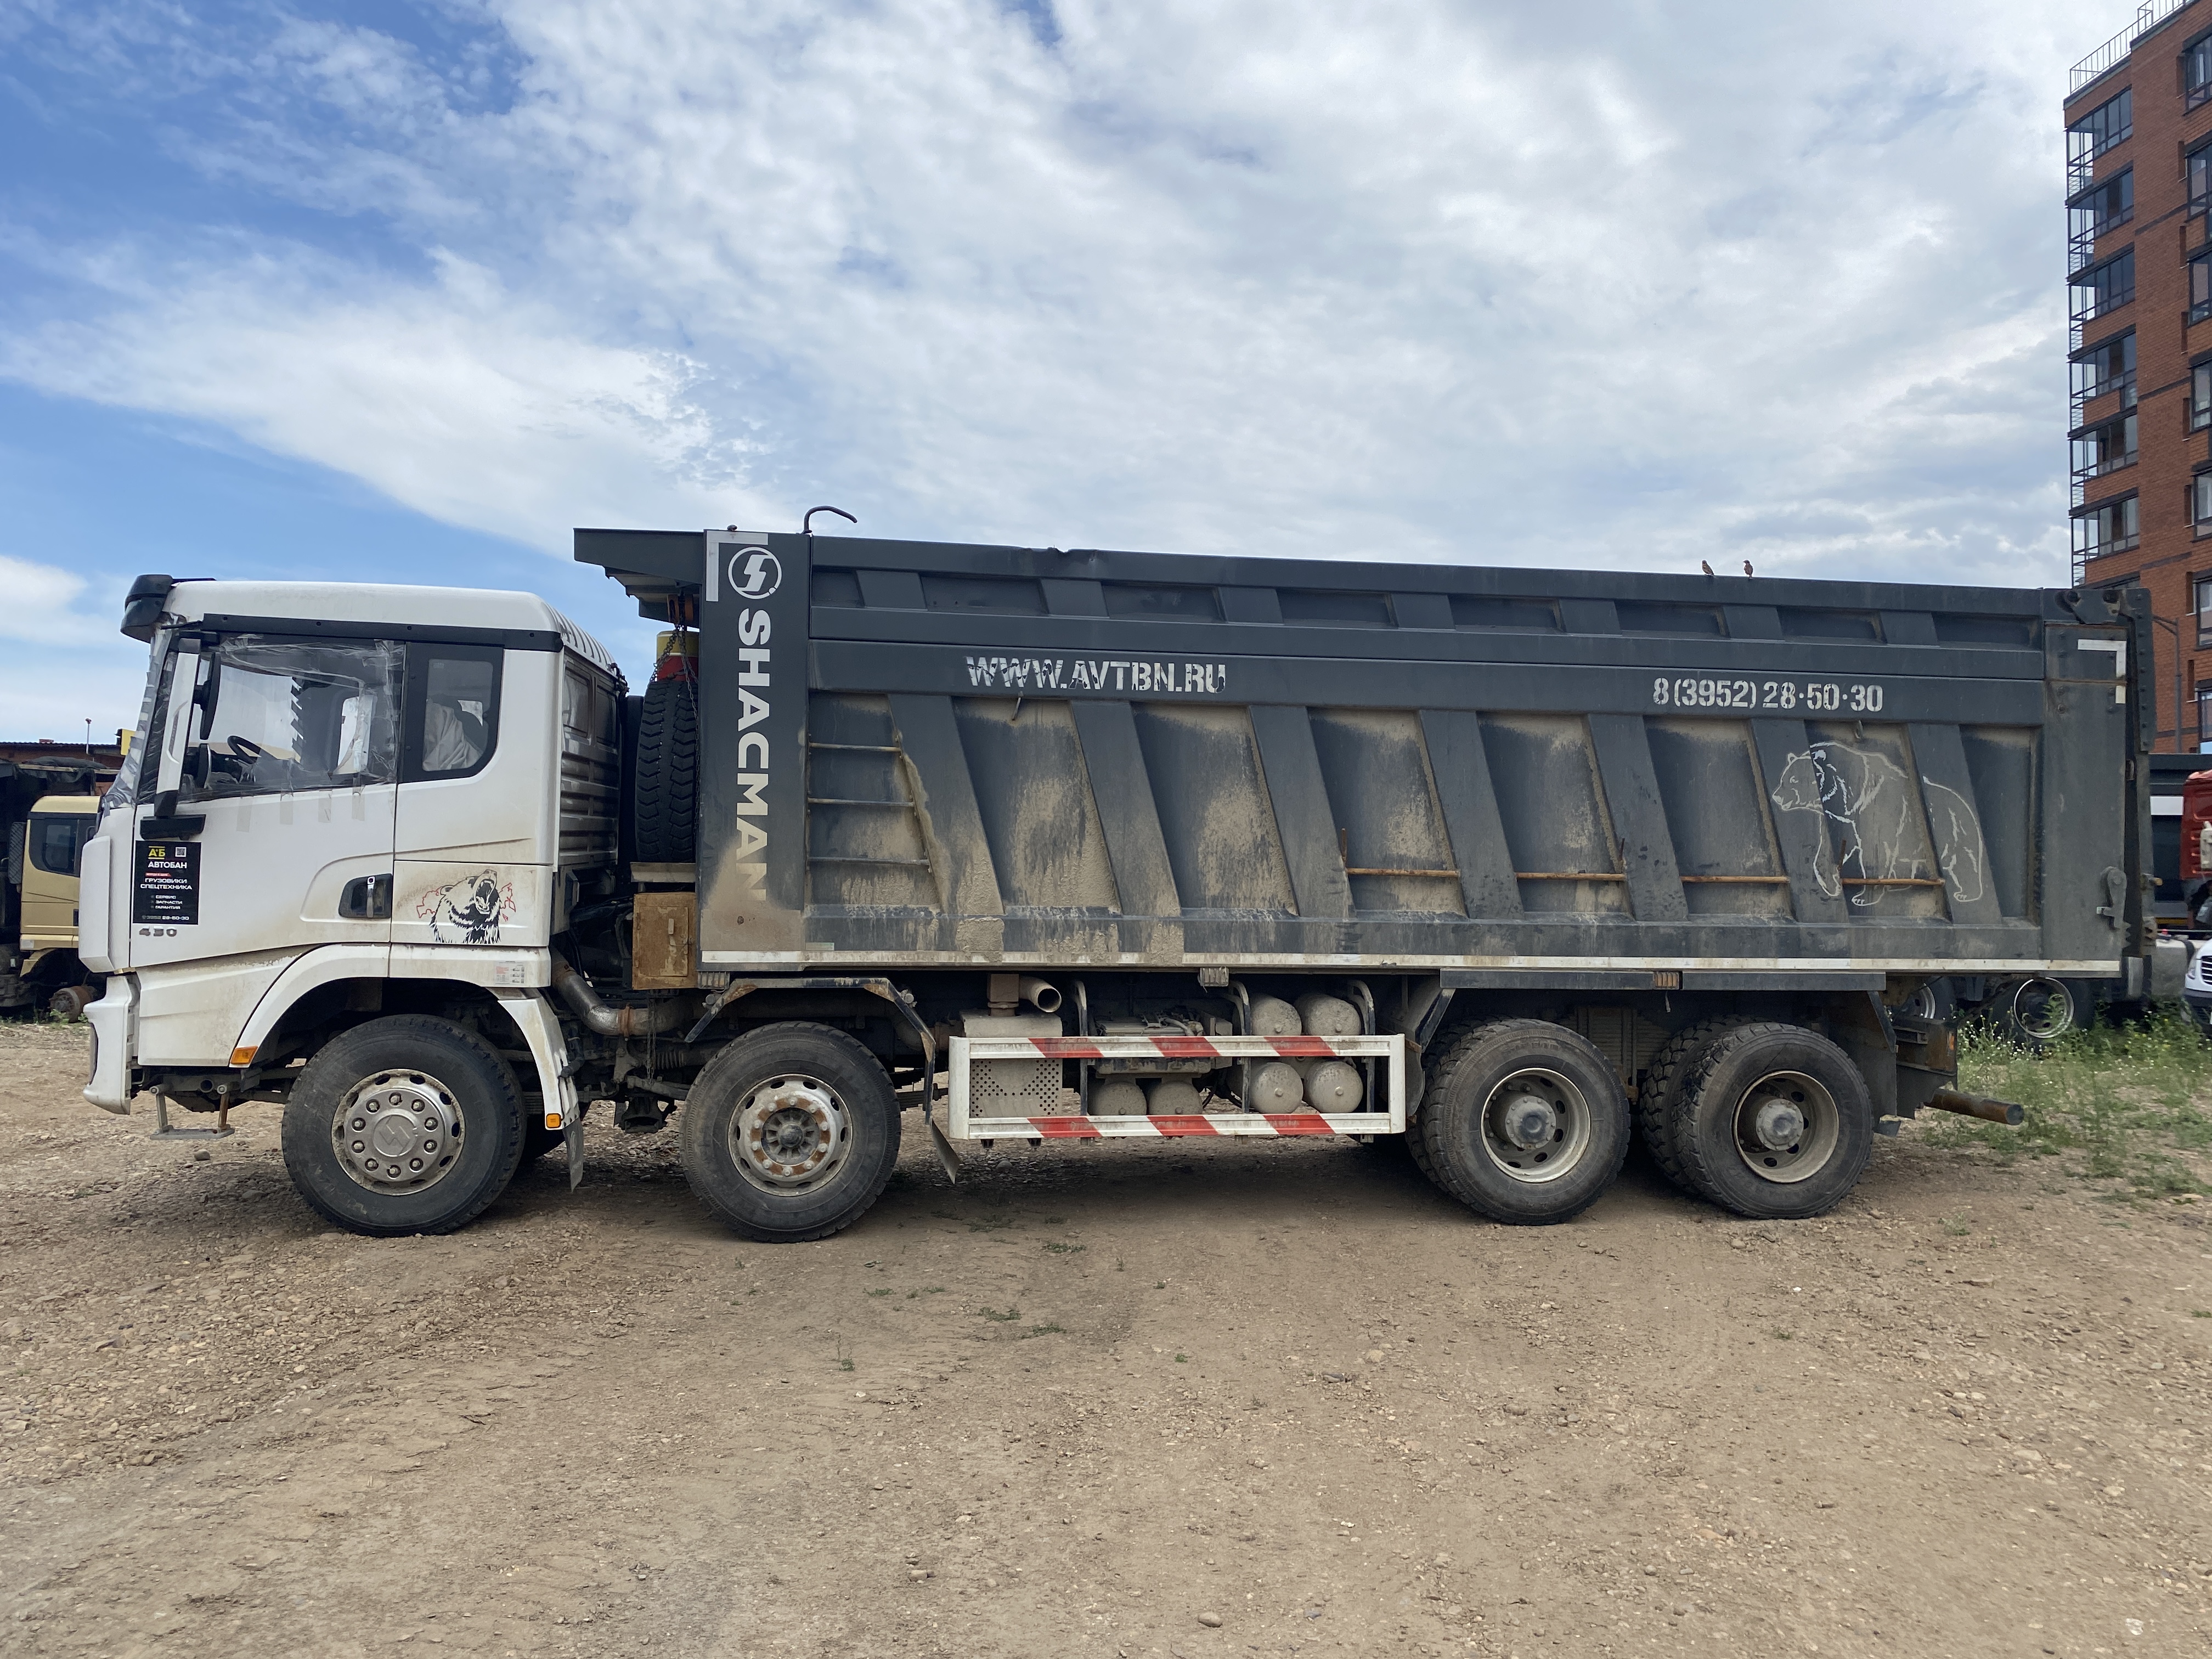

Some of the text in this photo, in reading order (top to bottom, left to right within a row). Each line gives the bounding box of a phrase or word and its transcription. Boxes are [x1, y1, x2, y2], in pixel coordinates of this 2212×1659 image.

[966, 656, 1227, 693] WWW.AVTBN.RU
[736, 607, 771, 901] SHACMAN
[148, 861, 187, 869] АВТОБАН
